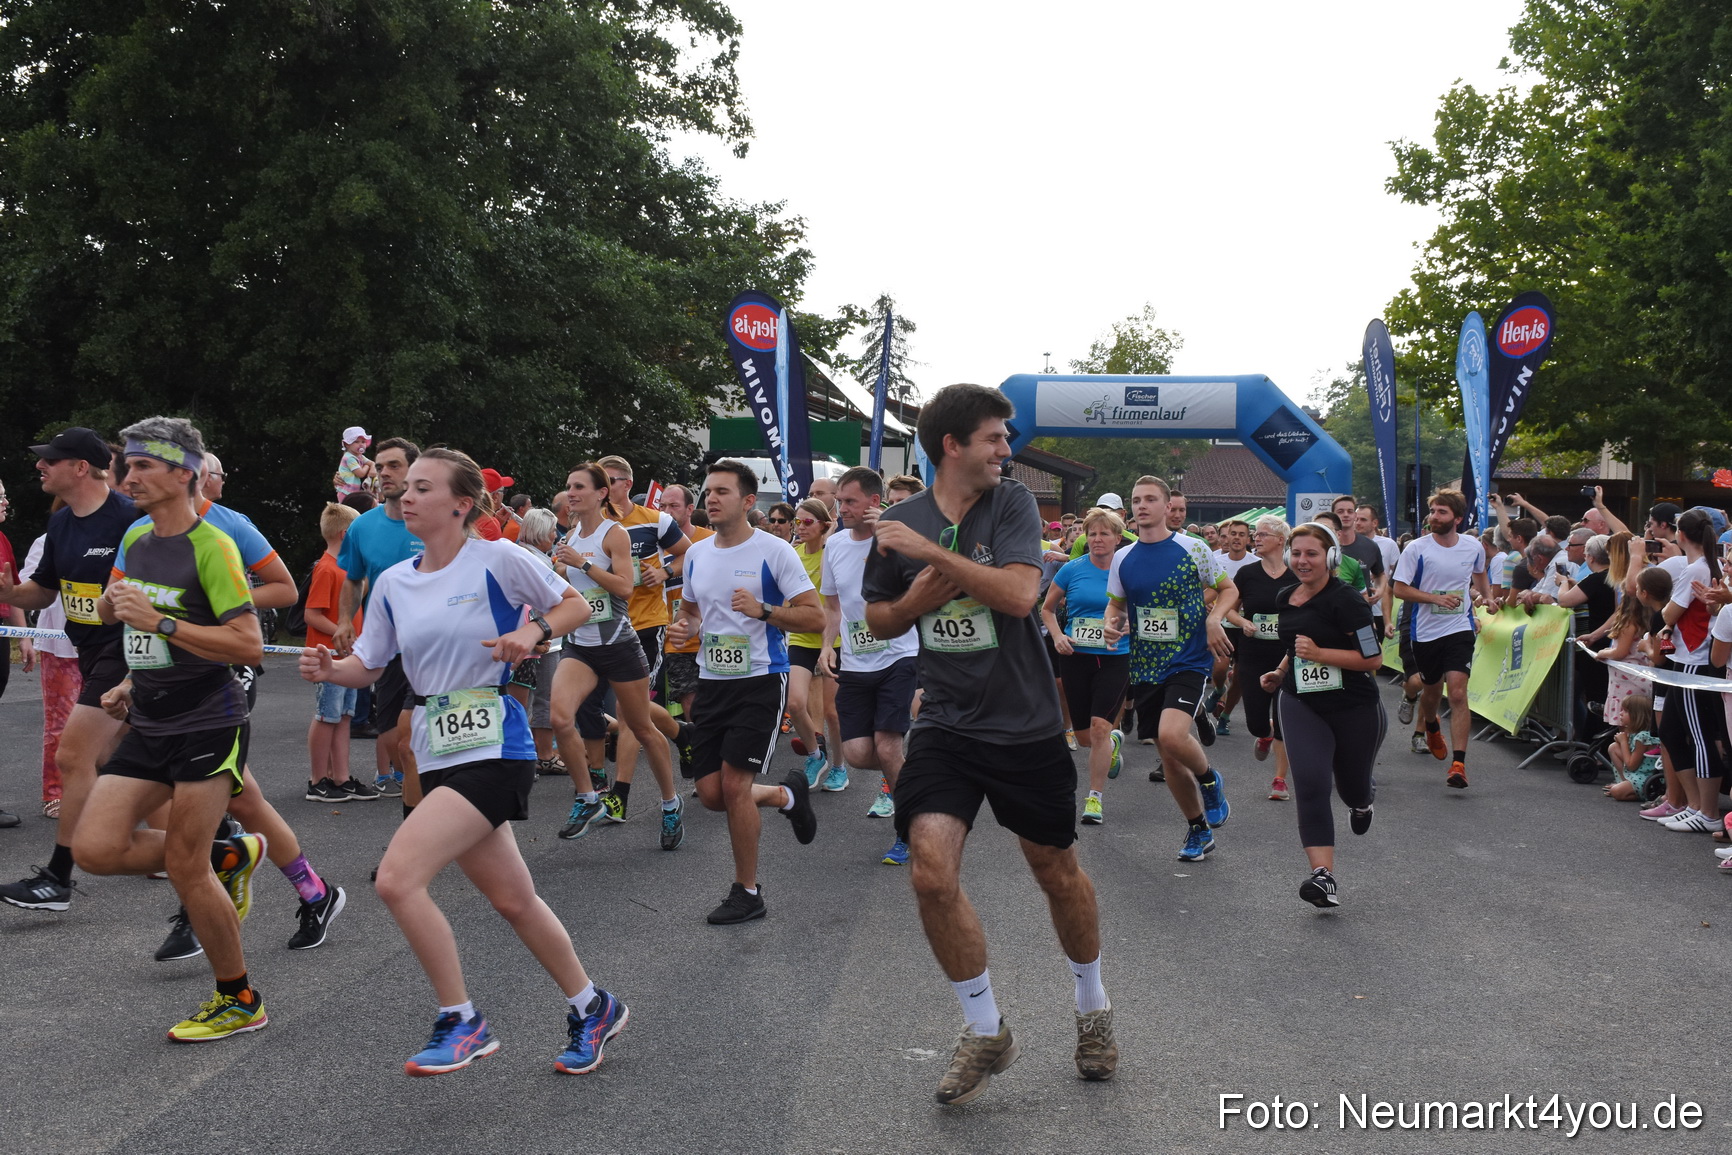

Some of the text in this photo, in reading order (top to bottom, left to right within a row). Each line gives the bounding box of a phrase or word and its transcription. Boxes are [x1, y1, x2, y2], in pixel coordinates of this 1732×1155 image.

[1502, 318, 1546, 345] Hervis
[1112, 407, 1187, 421] firmenlauf
[65, 595, 95, 613] 1413
[932, 619, 976, 638] 403
[1075, 627, 1103, 640] 1729
[1144, 619, 1169, 632] 254
[1260, 623, 1279, 633] 845
[128, 635, 151, 654] 327
[852, 631, 880, 646] 135
[708, 647, 743, 664] 1838
[1301, 666, 1330, 682] 846
[435, 708, 491, 738] 1843
